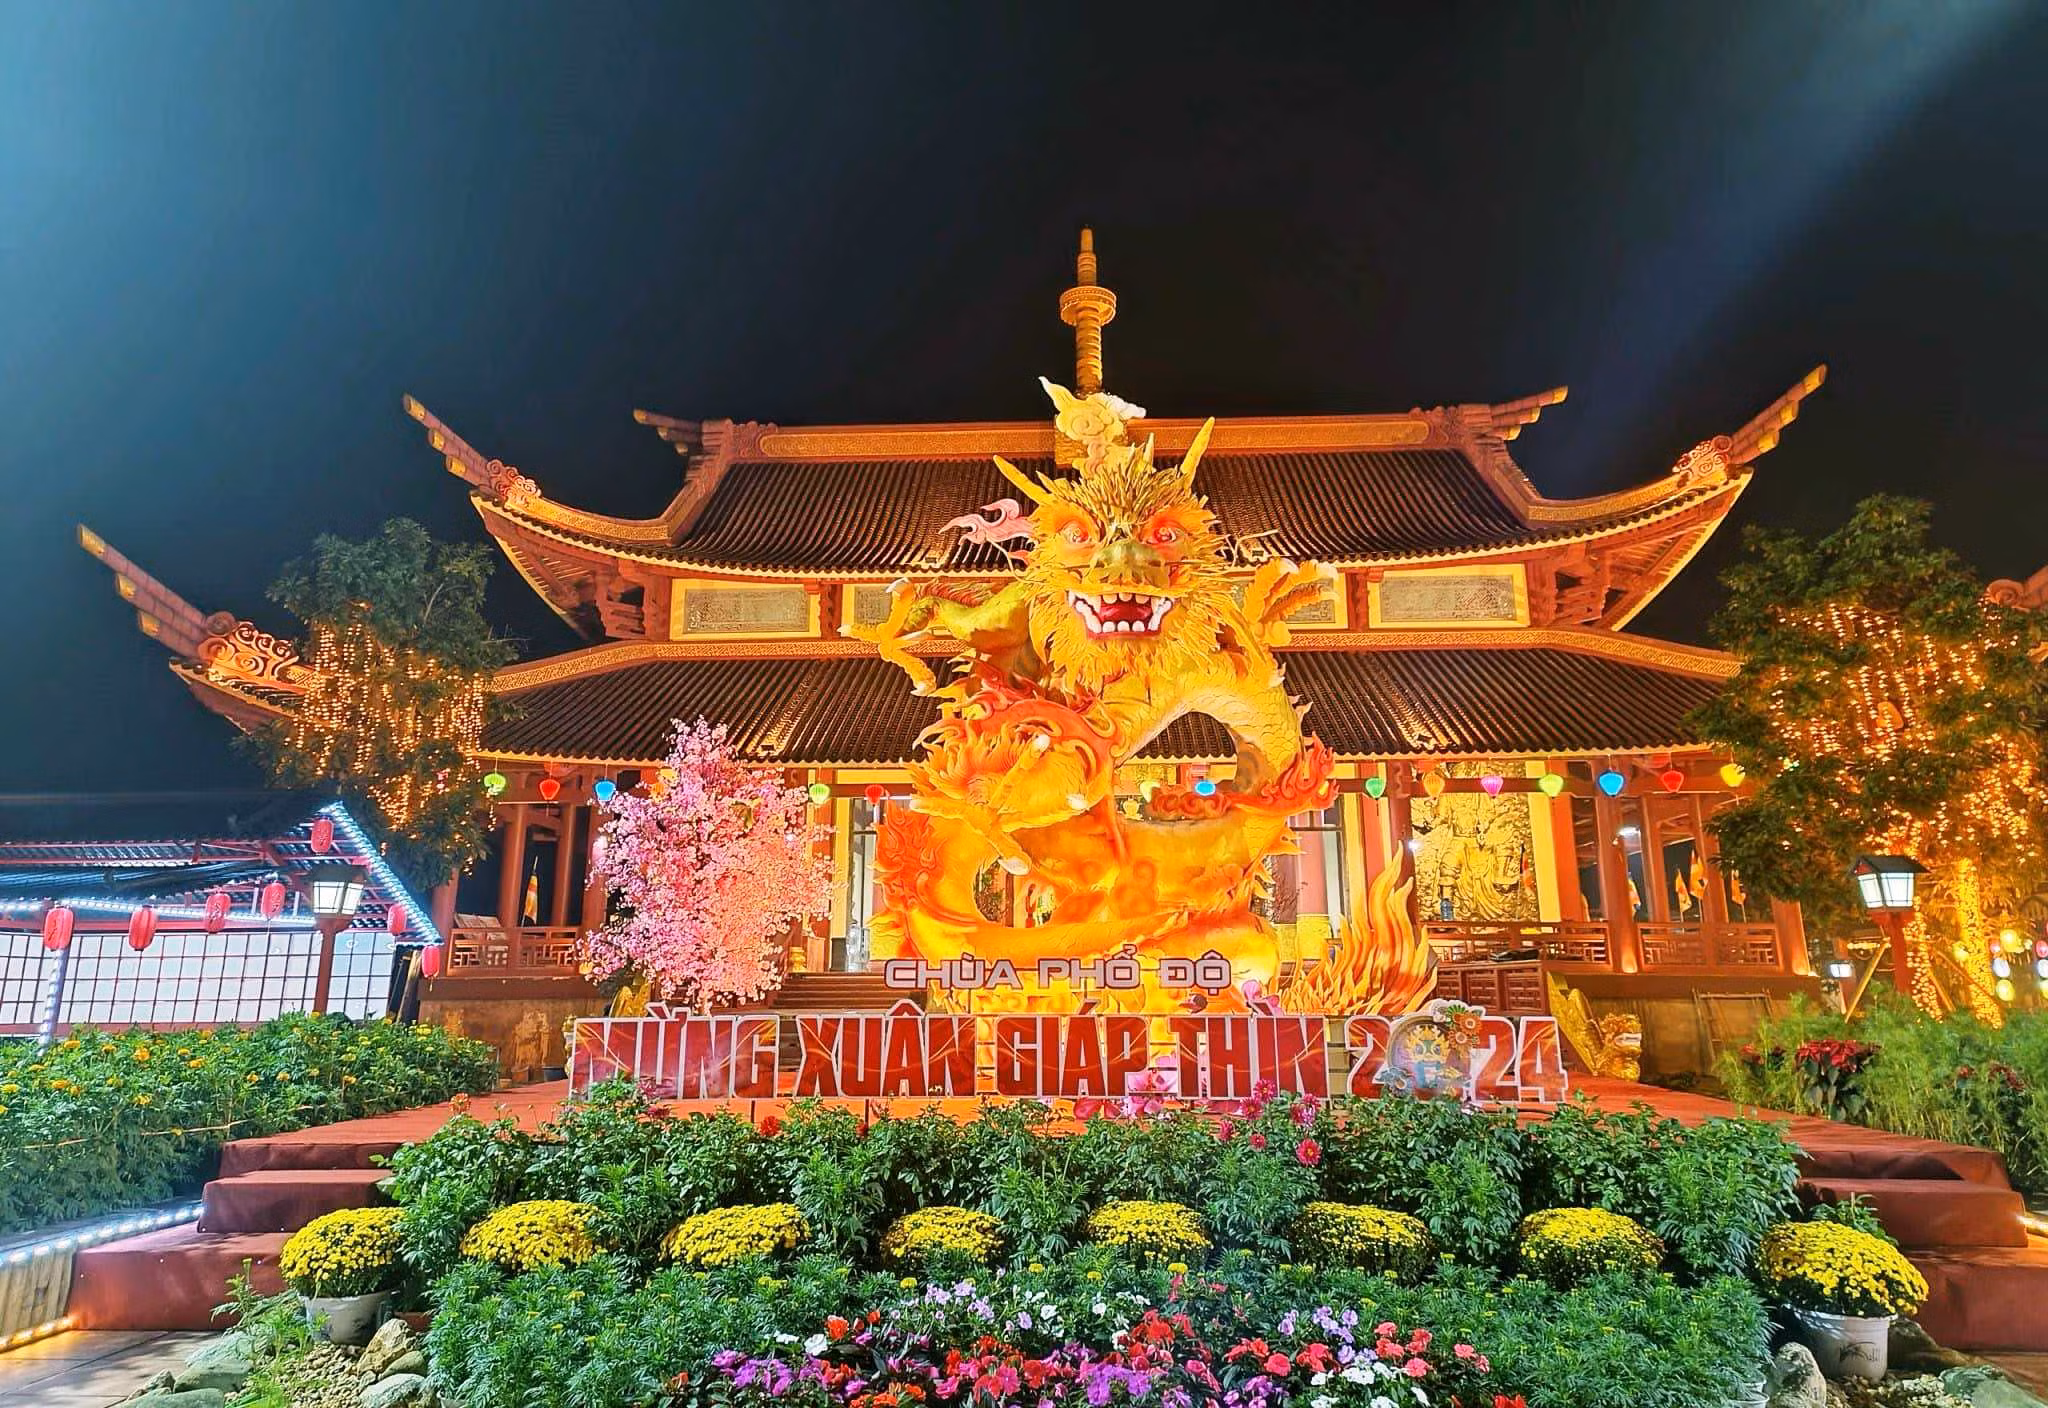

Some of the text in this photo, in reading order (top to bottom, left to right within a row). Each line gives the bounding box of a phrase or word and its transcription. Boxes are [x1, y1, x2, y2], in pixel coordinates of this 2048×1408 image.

[884, 944, 1231, 996] CHÙA PHỔ ĐỘ
[569, 1001, 780, 1100] MỪNG
[795, 999, 977, 1098] XUÂN
[994, 999, 1149, 1099] GIÁP
[1168, 999, 1330, 1099] THÌN
